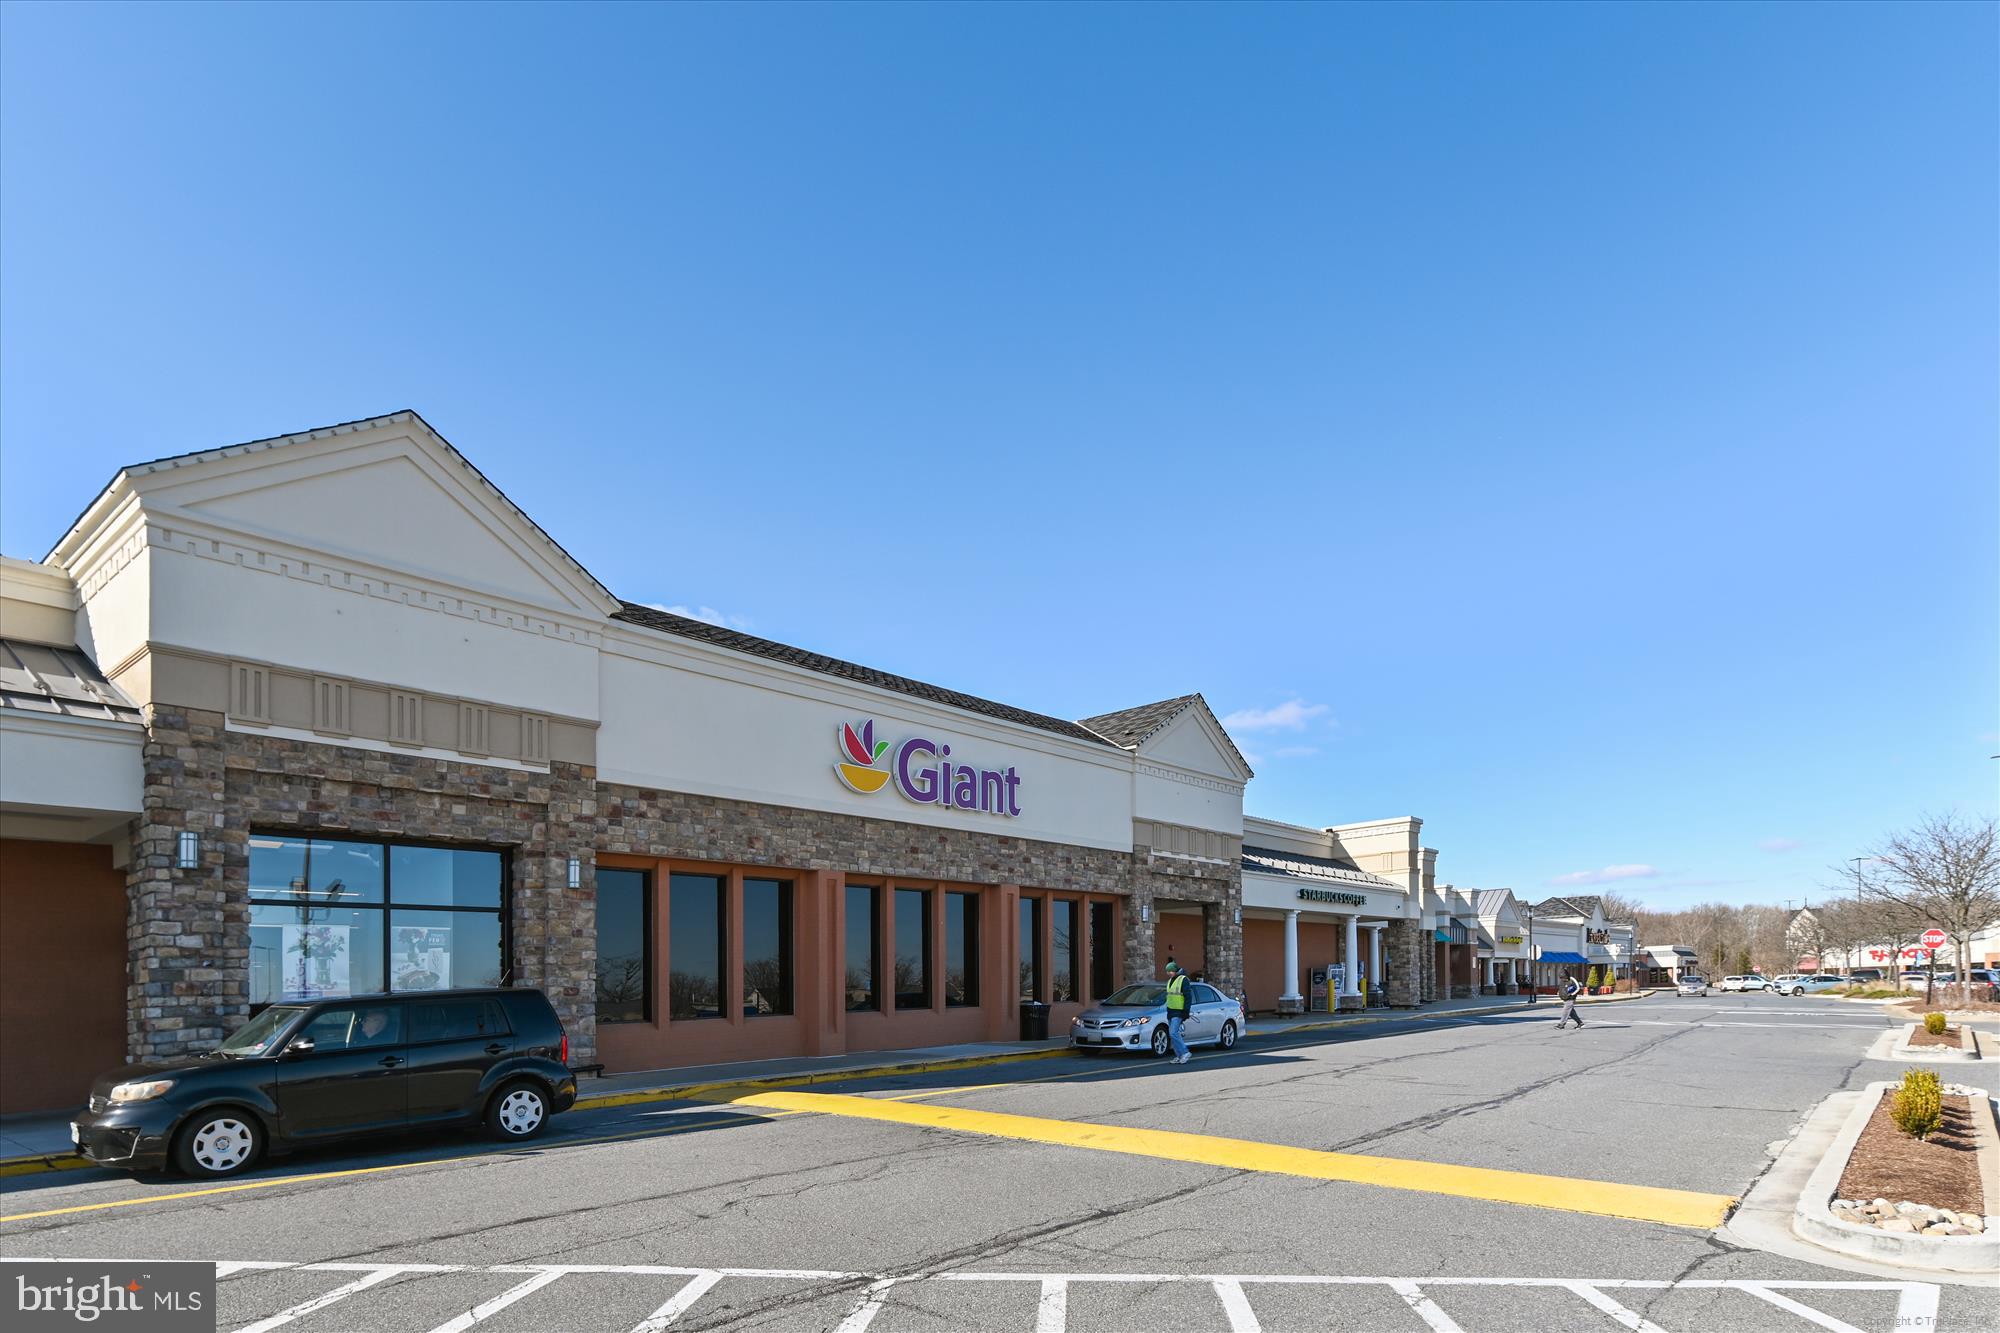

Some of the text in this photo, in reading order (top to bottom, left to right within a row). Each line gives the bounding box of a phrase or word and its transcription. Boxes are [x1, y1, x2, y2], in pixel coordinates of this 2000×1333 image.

[894, 737, 1022, 817] Giant
[1302, 889, 1367, 906] STARBUCKS COFFEE
[1923, 935, 1945, 943] STOP
